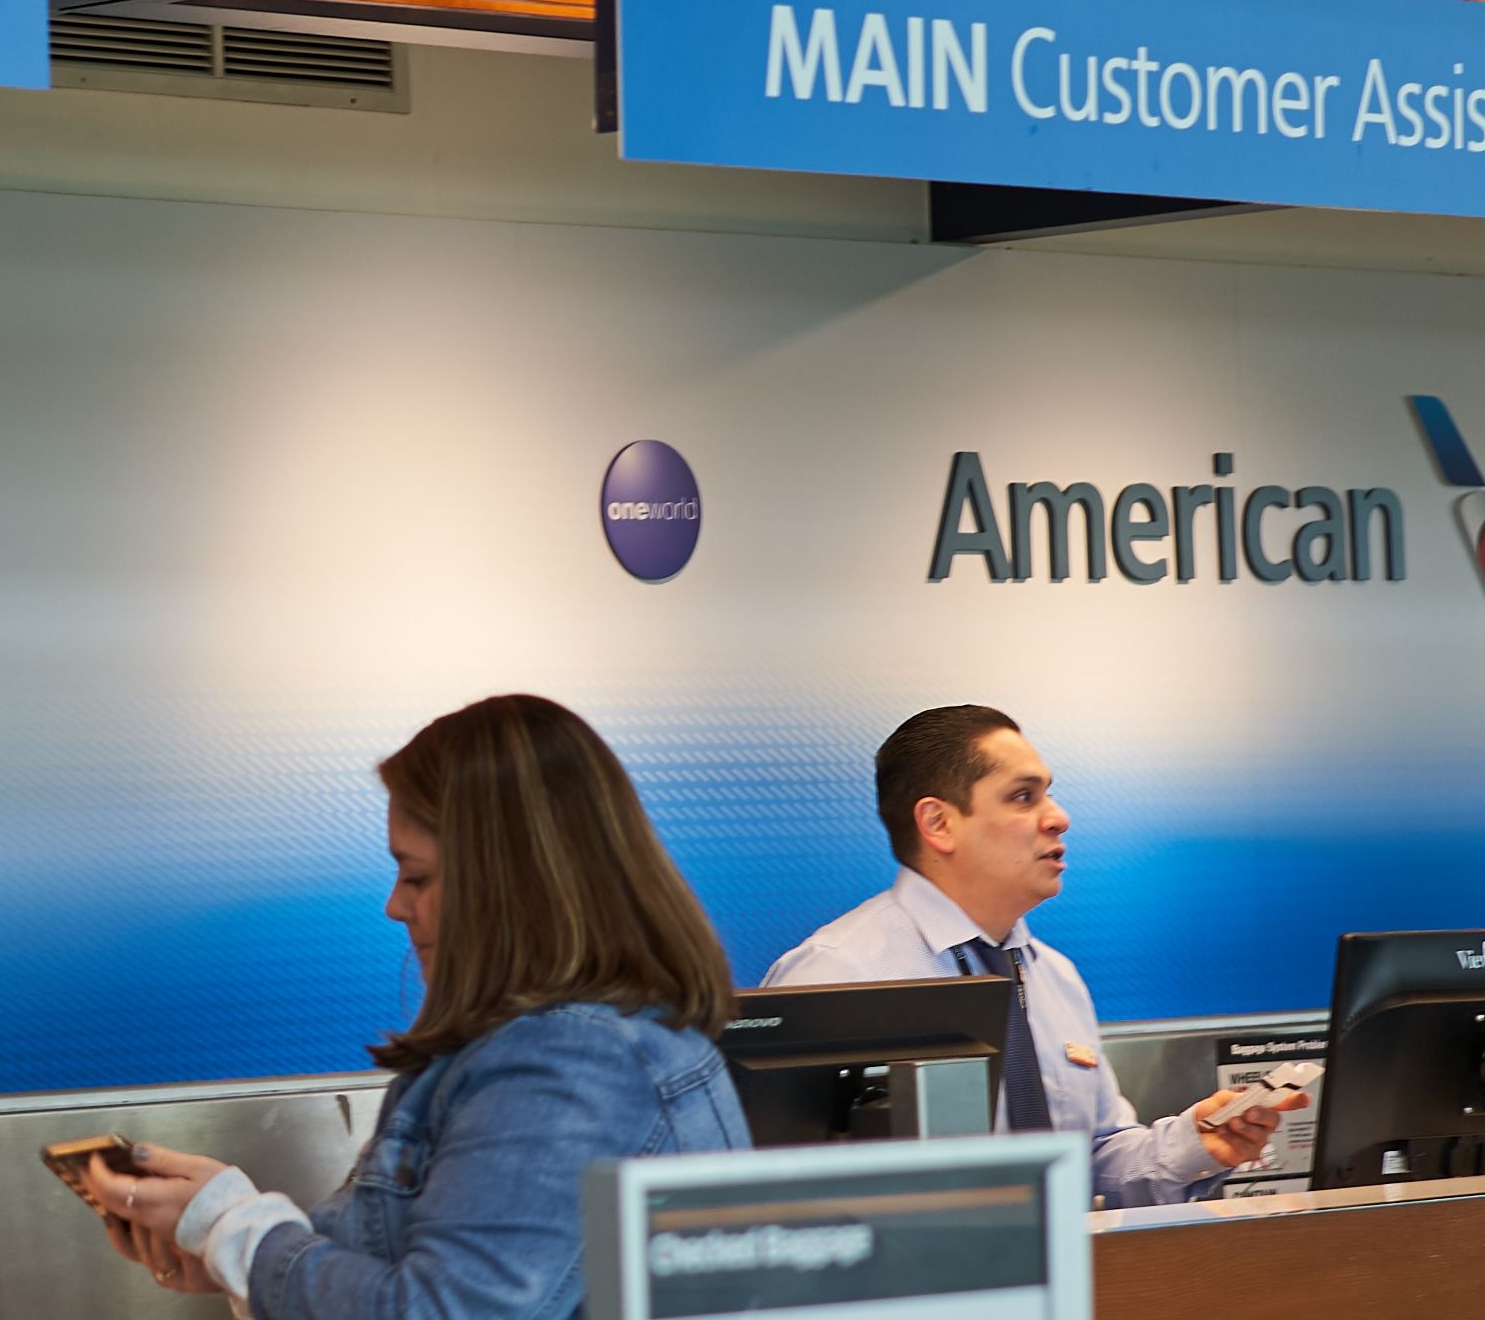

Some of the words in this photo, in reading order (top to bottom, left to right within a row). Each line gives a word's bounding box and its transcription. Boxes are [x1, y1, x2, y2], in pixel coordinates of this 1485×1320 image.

[764, 3, 989, 115] MAIN
[1010, 25, 1342, 140] Customer
[606, 496, 699, 522] oneworld
[927, 451, 1406, 584] American
